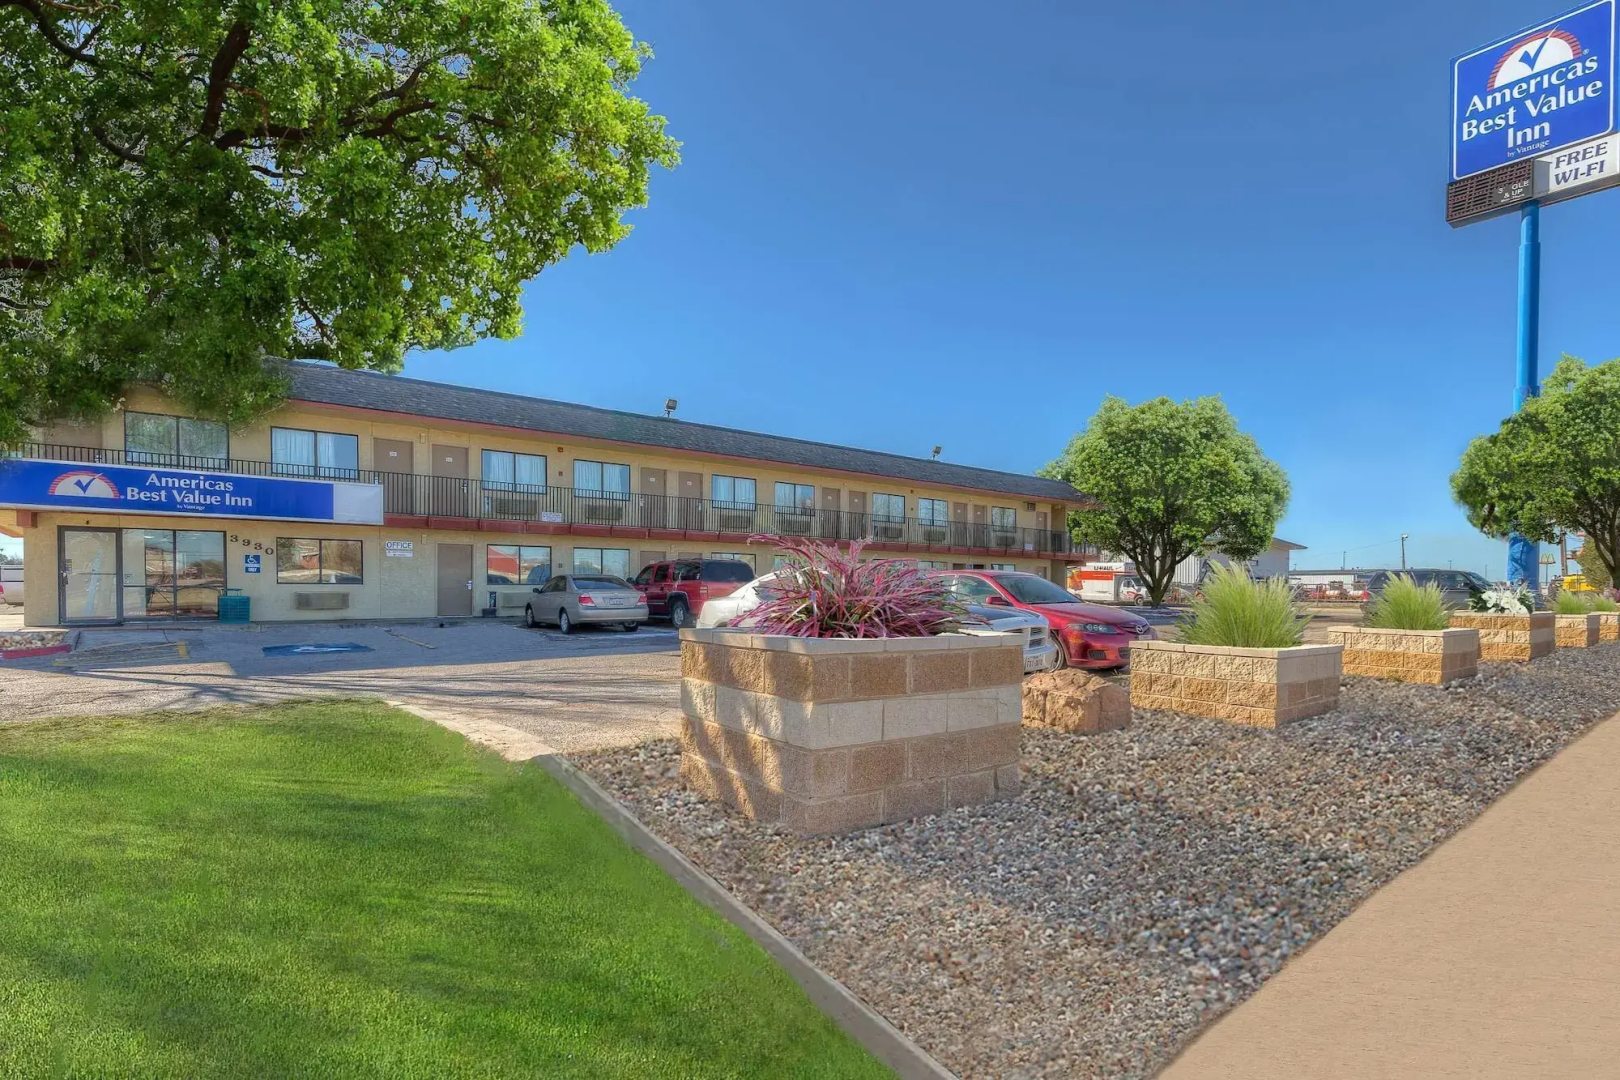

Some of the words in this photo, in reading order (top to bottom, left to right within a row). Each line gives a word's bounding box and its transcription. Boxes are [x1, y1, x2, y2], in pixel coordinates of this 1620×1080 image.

[1465, 54, 1599, 117] Americas
[1462, 106, 1517, 142] Best
[1524, 80, 1603, 118] Value
[1507, 122, 1550, 148] Inn
[1507, 150, 1516, 158] by
[1516, 139, 1550, 154] Vantage
[1554, 142, 1609, 169] FREE
[1554, 160, 1605, 187] WI-FI
[145, 473, 234, 492] Americas
[126, 486, 168, 502] Best
[172, 489, 221, 505] Value
[225, 493, 253, 507] Inn
[230, 534, 274, 556] 3930
[386, 541, 413, 549] OFFICE
